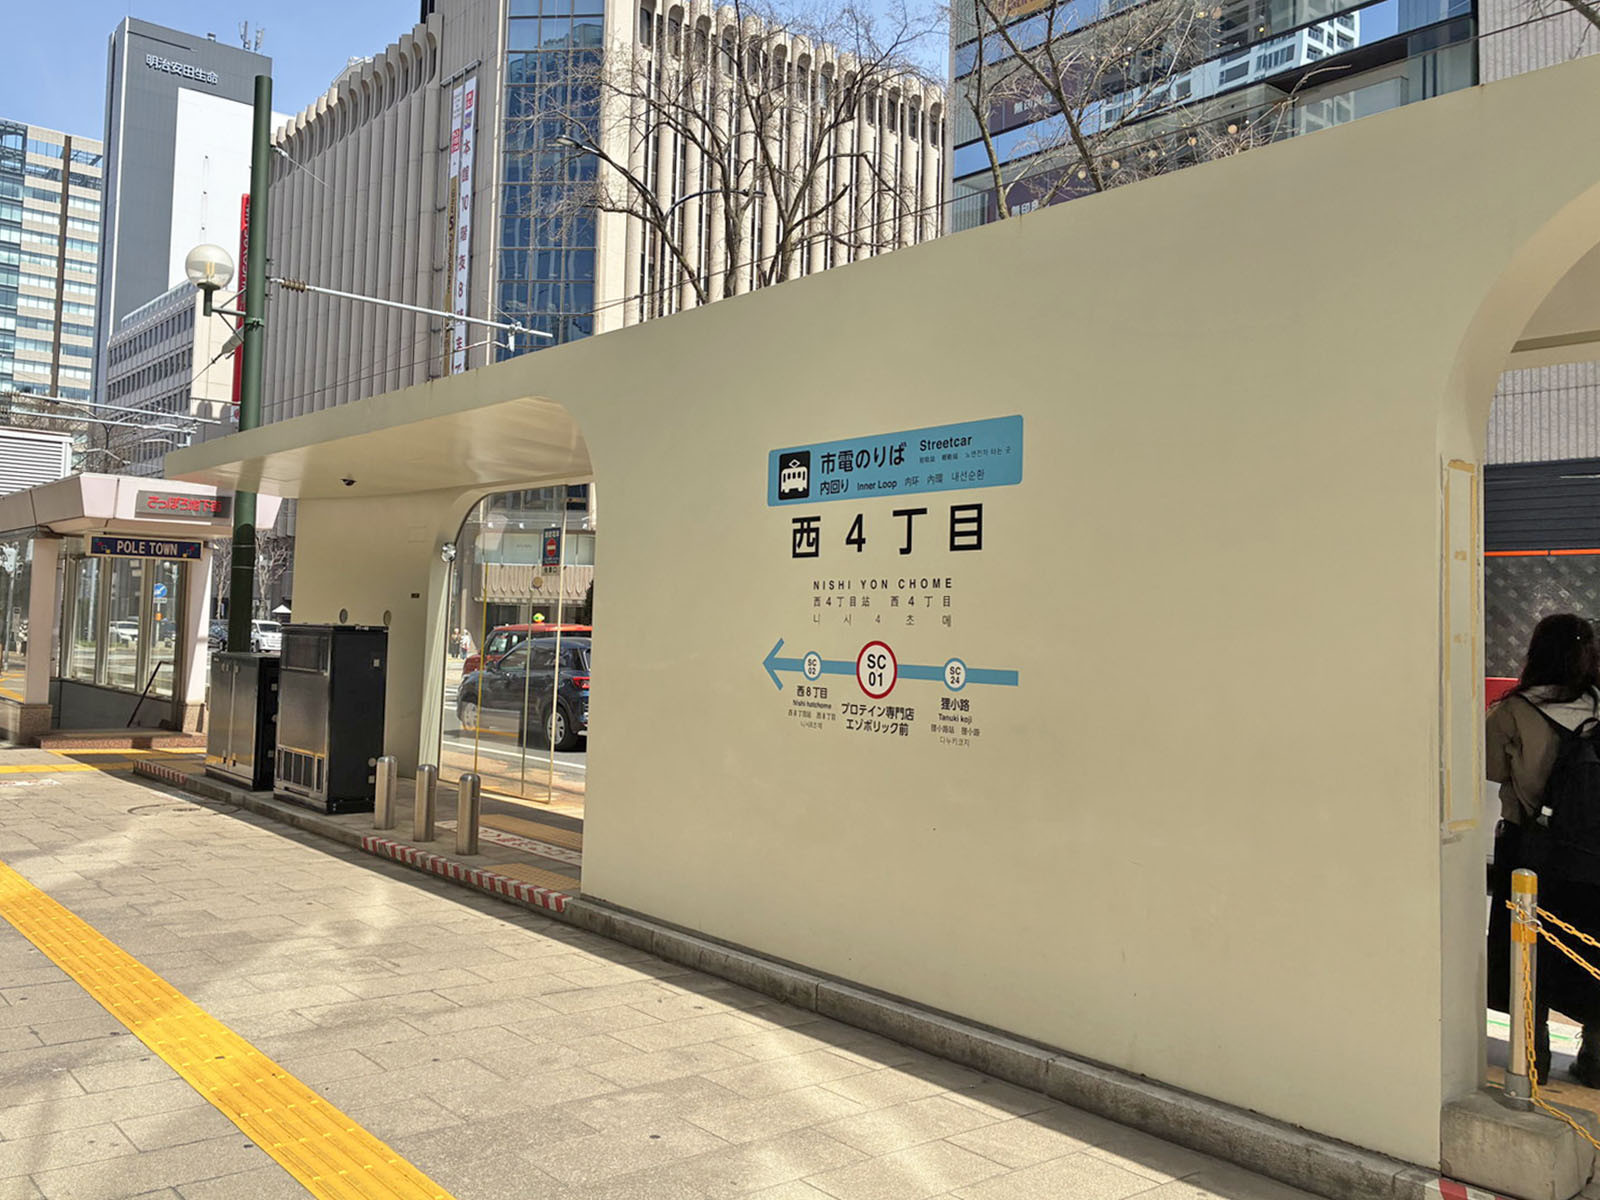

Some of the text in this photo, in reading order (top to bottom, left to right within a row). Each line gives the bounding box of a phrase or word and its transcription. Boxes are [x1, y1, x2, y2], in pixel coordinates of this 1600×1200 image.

[145, 54, 219, 84] 明治安田生命
[920, 436, 973, 452] Streetcar
[821, 441, 907, 475] 市電のりば
[820, 478, 849, 495] 内回り
[857, 480, 898, 491] Inner Loop
[792, 503, 983, 559] 西4丁目
[116, 540, 179, 556] POLE TOWN
[813, 577, 952, 591] NISHI YON CHOME
[807, 658, 817, 667] SC
[867, 653, 887, 670] SC
[807, 667, 816, 676] 02
[868, 671, 884, 687] 01
[949, 666, 961, 676] SC
[950, 675, 960, 685] 24
[796, 685, 828, 699] 西8丁目
[841, 702, 915, 721] プロテイン専門店
[941, 697, 969, 712] 狸小路
